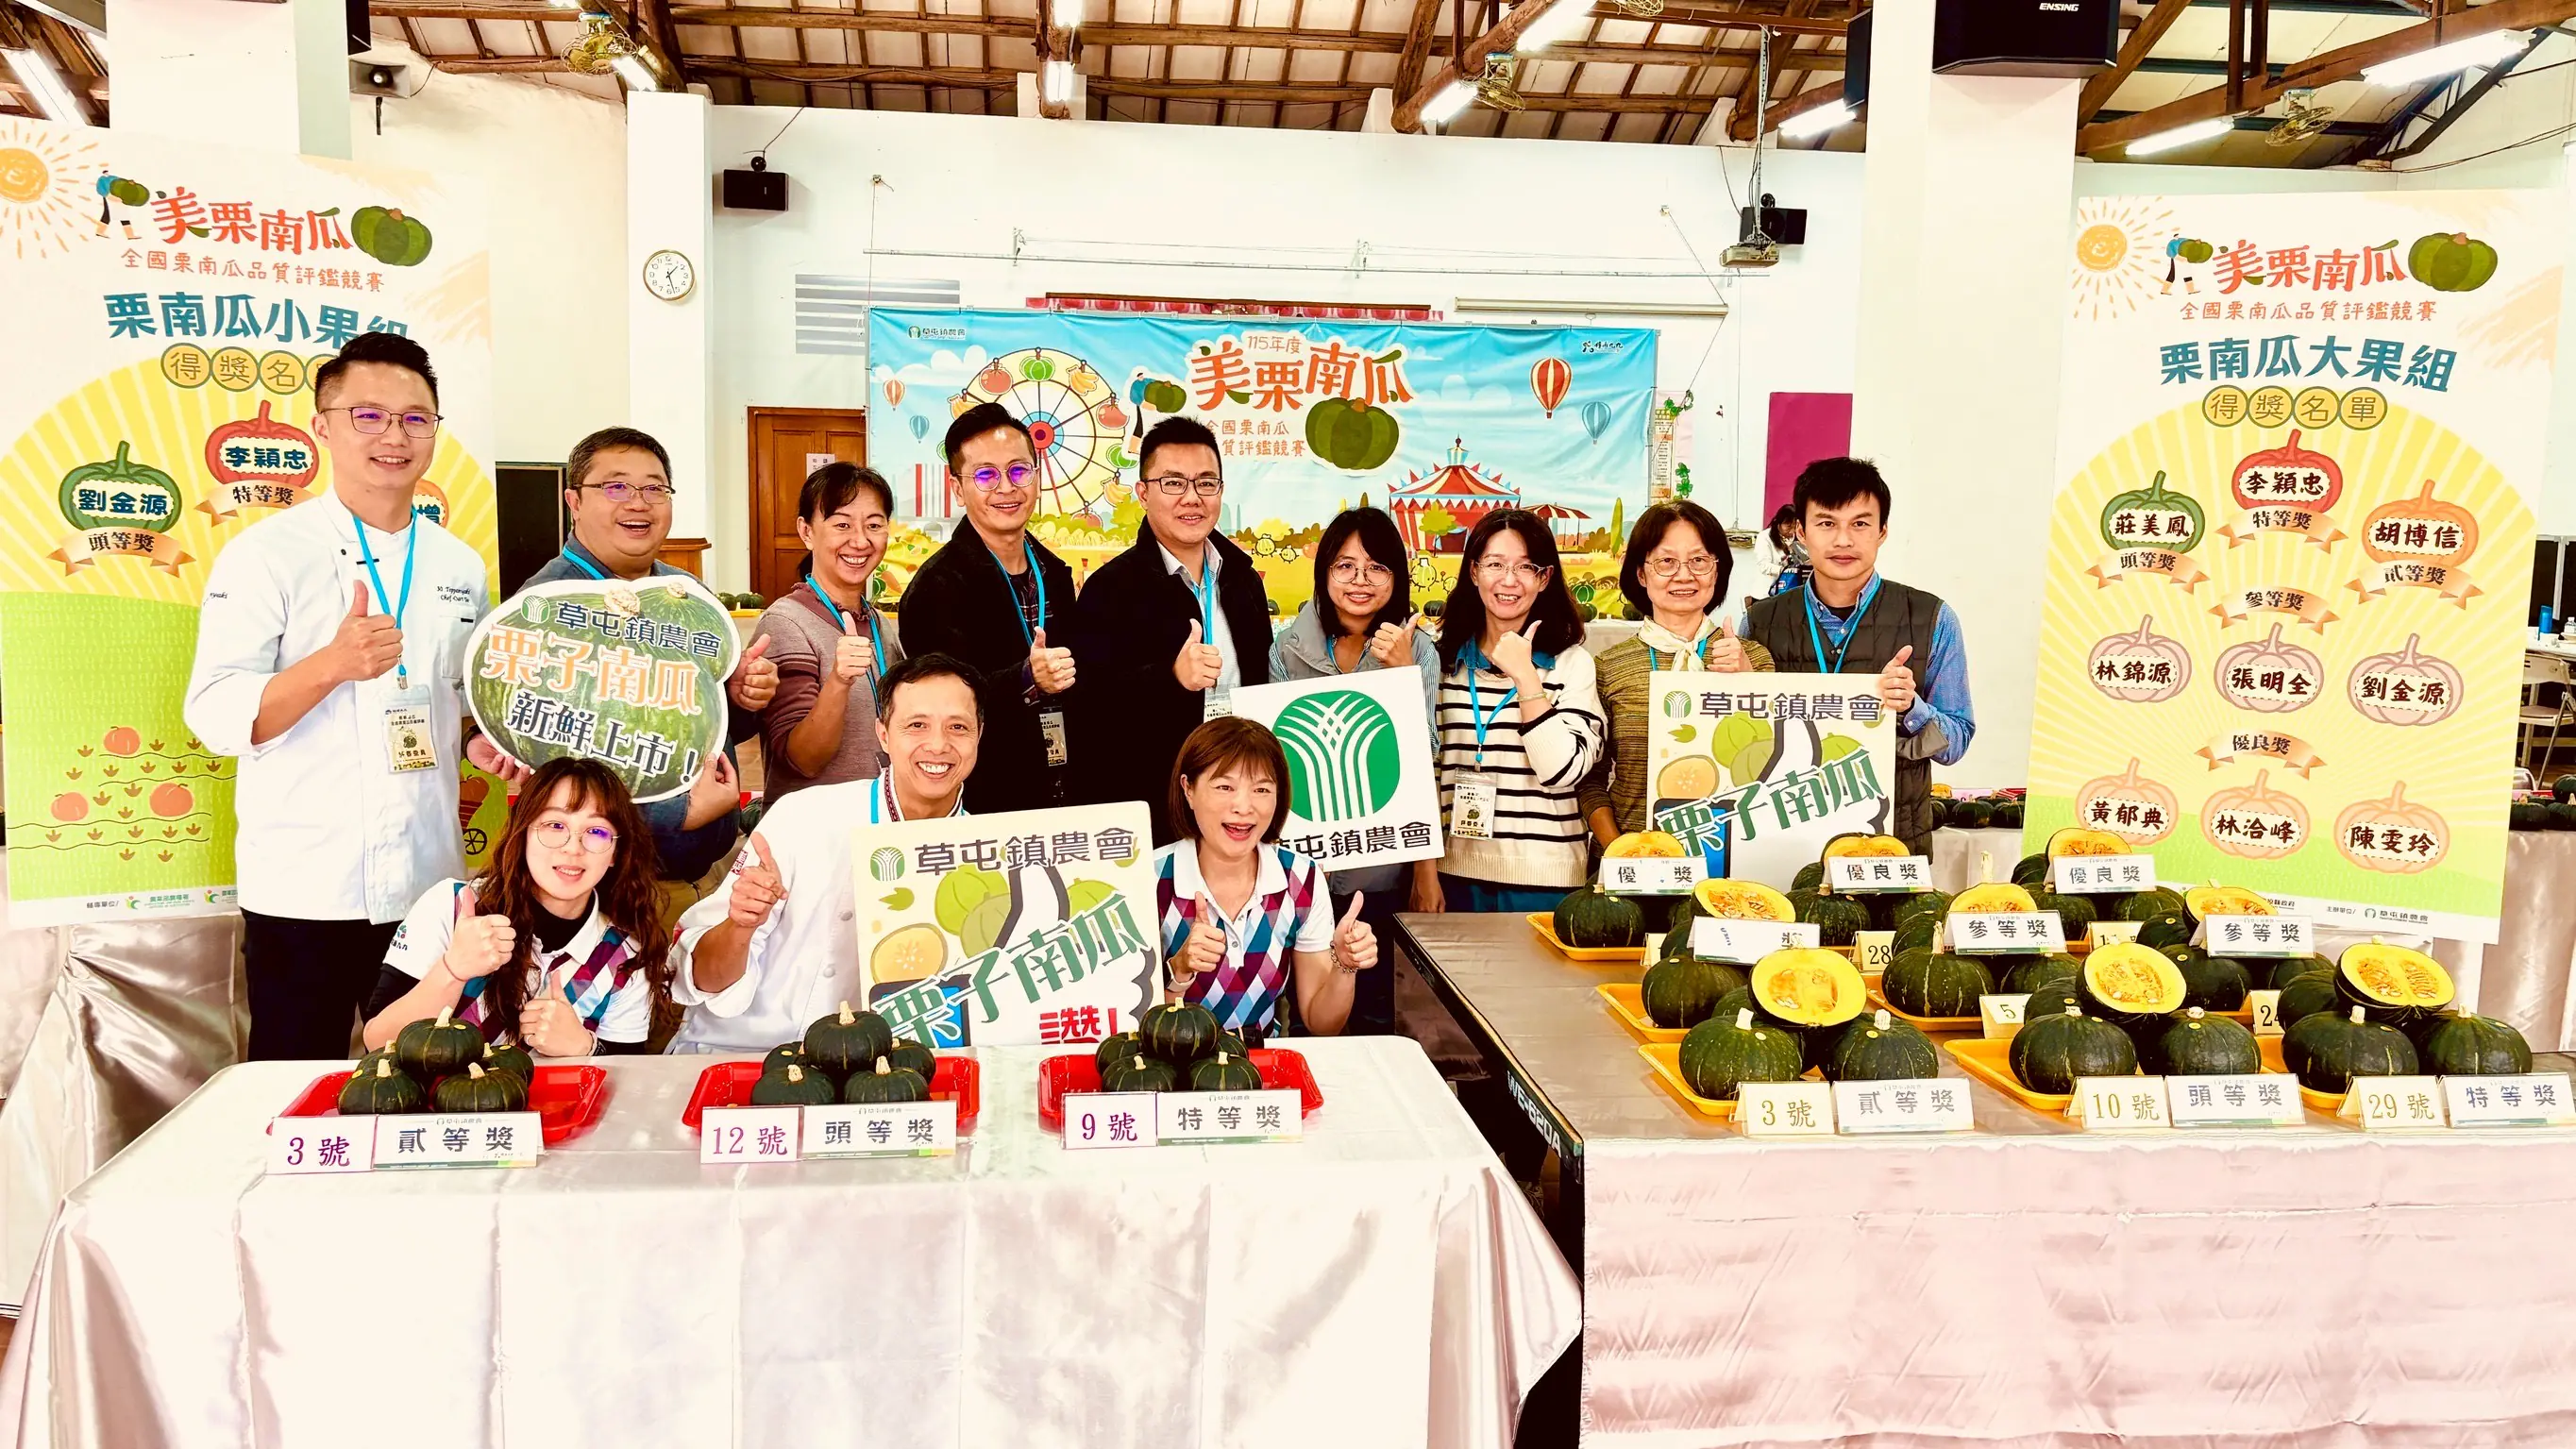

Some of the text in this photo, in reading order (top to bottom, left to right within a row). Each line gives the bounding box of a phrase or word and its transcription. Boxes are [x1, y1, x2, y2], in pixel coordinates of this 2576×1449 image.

[2039, 2, 2079, 11] ENSING
[151, 186, 353, 256] 美栗南瓜
[121, 247, 385, 293] 全國栗南瓜品質評鑑競賽
[2213, 239, 2408, 295] 美栗南瓜
[2180, 301, 2437, 323] 全國栗南瓜品質評鑑競賽
[1247, 335, 1303, 355] 115年度
[170, 351, 328, 389] 得獎名
[1191, 341, 1413, 413] 美栗南瓜
[2160, 334, 2458, 392] 栗南瓜大果組
[2211, 395, 2378, 423] 得獎名單
[225, 446, 309, 470] 李穎忠
[232, 484, 295, 506] 特等獎
[2245, 471, 2325, 497] 李穎忠
[78, 488, 168, 516] 劉金源
[2114, 514, 2190, 538] 莊美鳳
[2252, 508, 2312, 531] 特等獎
[89, 531, 155, 553] 頭等獎
[2375, 523, 2459, 550] 胡博信
[2120, 550, 2177, 573] 頭等獎
[556, 601, 722, 658] 草屯鎮農會
[480, 624, 702, 716] 栗子南瓜
[2095, 658, 2174, 684] 林錦源
[2231, 666, 2313, 697] 張明全
[2361, 675, 2447, 706] 劉金源
[1699, 692, 1882, 721] 草屯鎮農會
[507, 691, 698, 784] 新鮮上市！
[2231, 733, 2292, 755] 優良獎
[1656, 749, 1884, 856] 栗子南瓜
[2215, 813, 2297, 844] 林洽峰
[2349, 827, 2435, 858] 陳雯玲
[914, 827, 1135, 876] 草屯鎮農會
[1618, 866, 1692, 884] 優獎
[1846, 864, 1919, 882] 優良獎
[2069, 865, 2141, 885] 優良獎
[1868, 945, 1892, 965] 28
[871, 893, 1152, 1048] 栗子南瓜
[2093, 1092, 2161, 1122] 10號
[2188, 1083, 2282, 1107] 頭等獎
[2368, 1092, 2435, 1120] 29號
[2466, 1085, 2557, 1108] 特等獎
[825, 1118, 934, 1145] 頭等獎
[1177, 1104, 1281, 1131] 特等獎
[398, 1126, 514, 1154] 貳等獎
[713, 1125, 788, 1156] 12號
